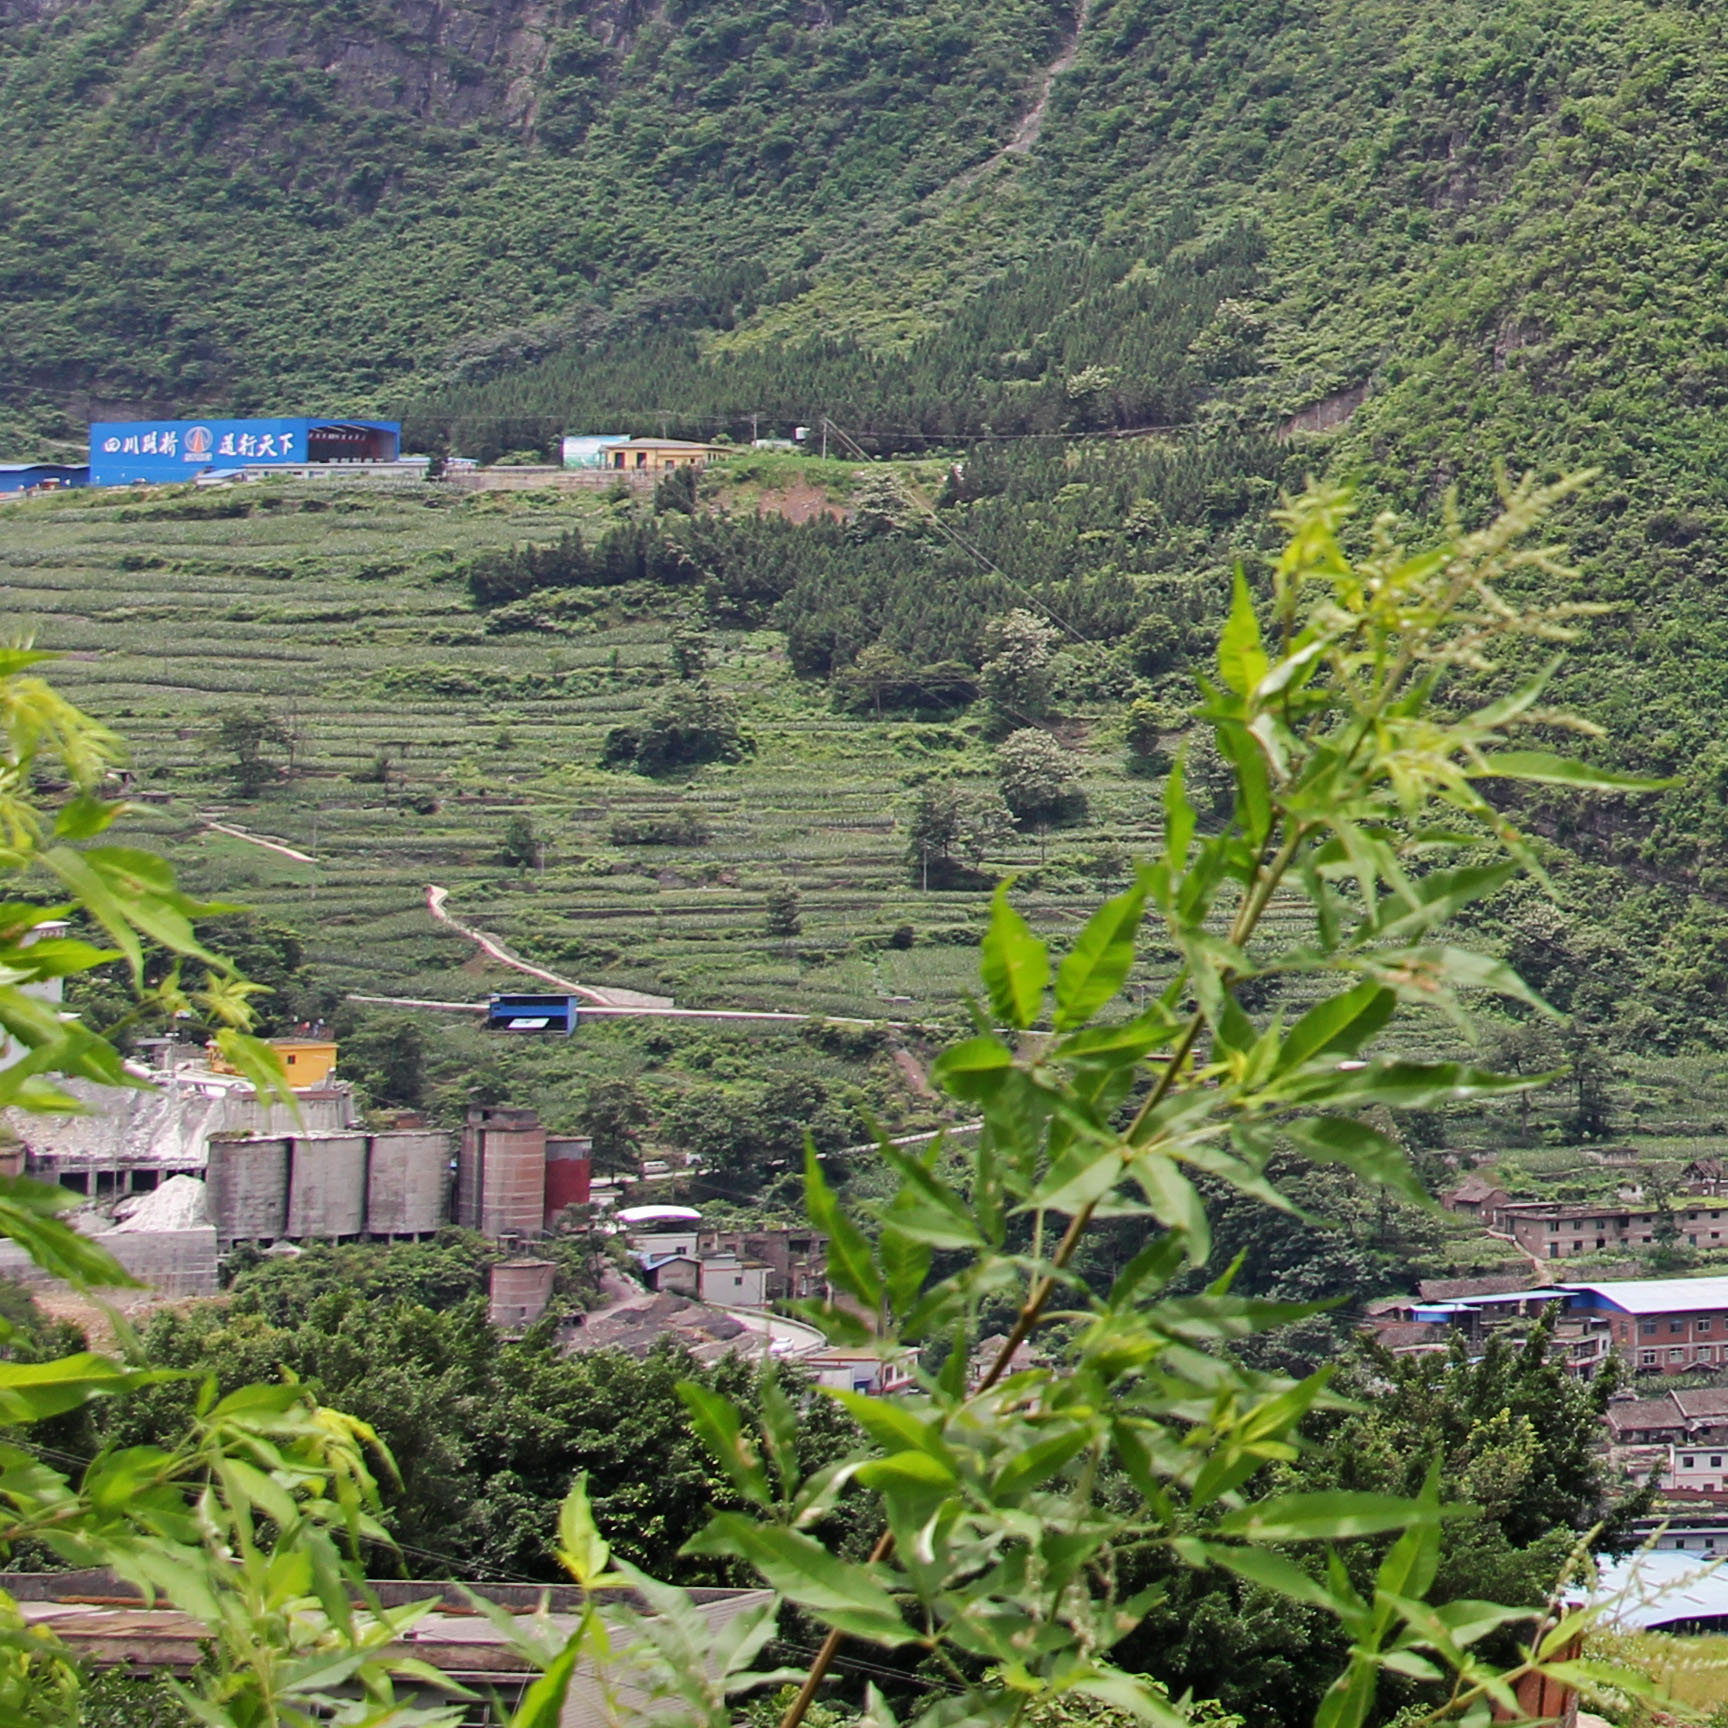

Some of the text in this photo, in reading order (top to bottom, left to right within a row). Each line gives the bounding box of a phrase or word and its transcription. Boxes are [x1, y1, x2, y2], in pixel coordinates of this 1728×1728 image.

[103, 431, 294, 457] 四川路桥 道行天下
